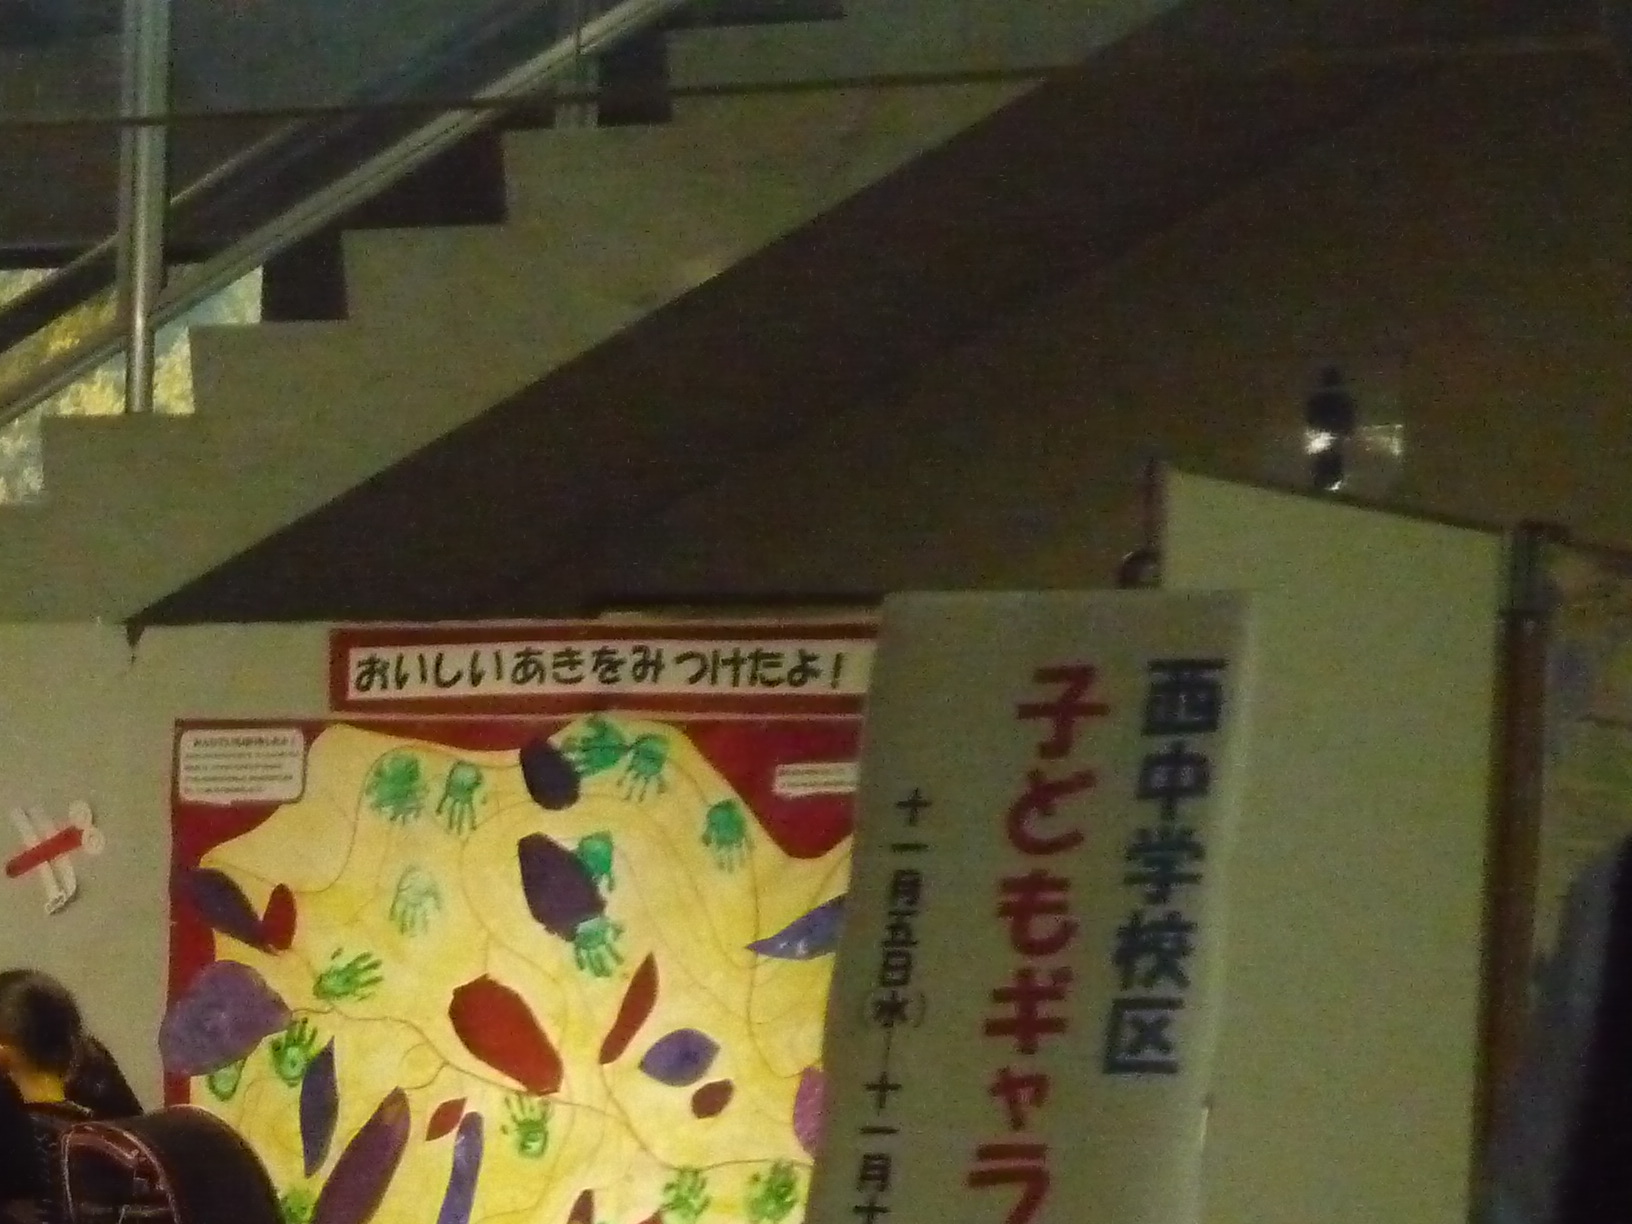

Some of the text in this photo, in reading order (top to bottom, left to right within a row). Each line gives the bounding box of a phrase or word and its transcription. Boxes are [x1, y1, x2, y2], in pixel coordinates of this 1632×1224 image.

[1103, 657, 1230, 1075] 西中学校区
